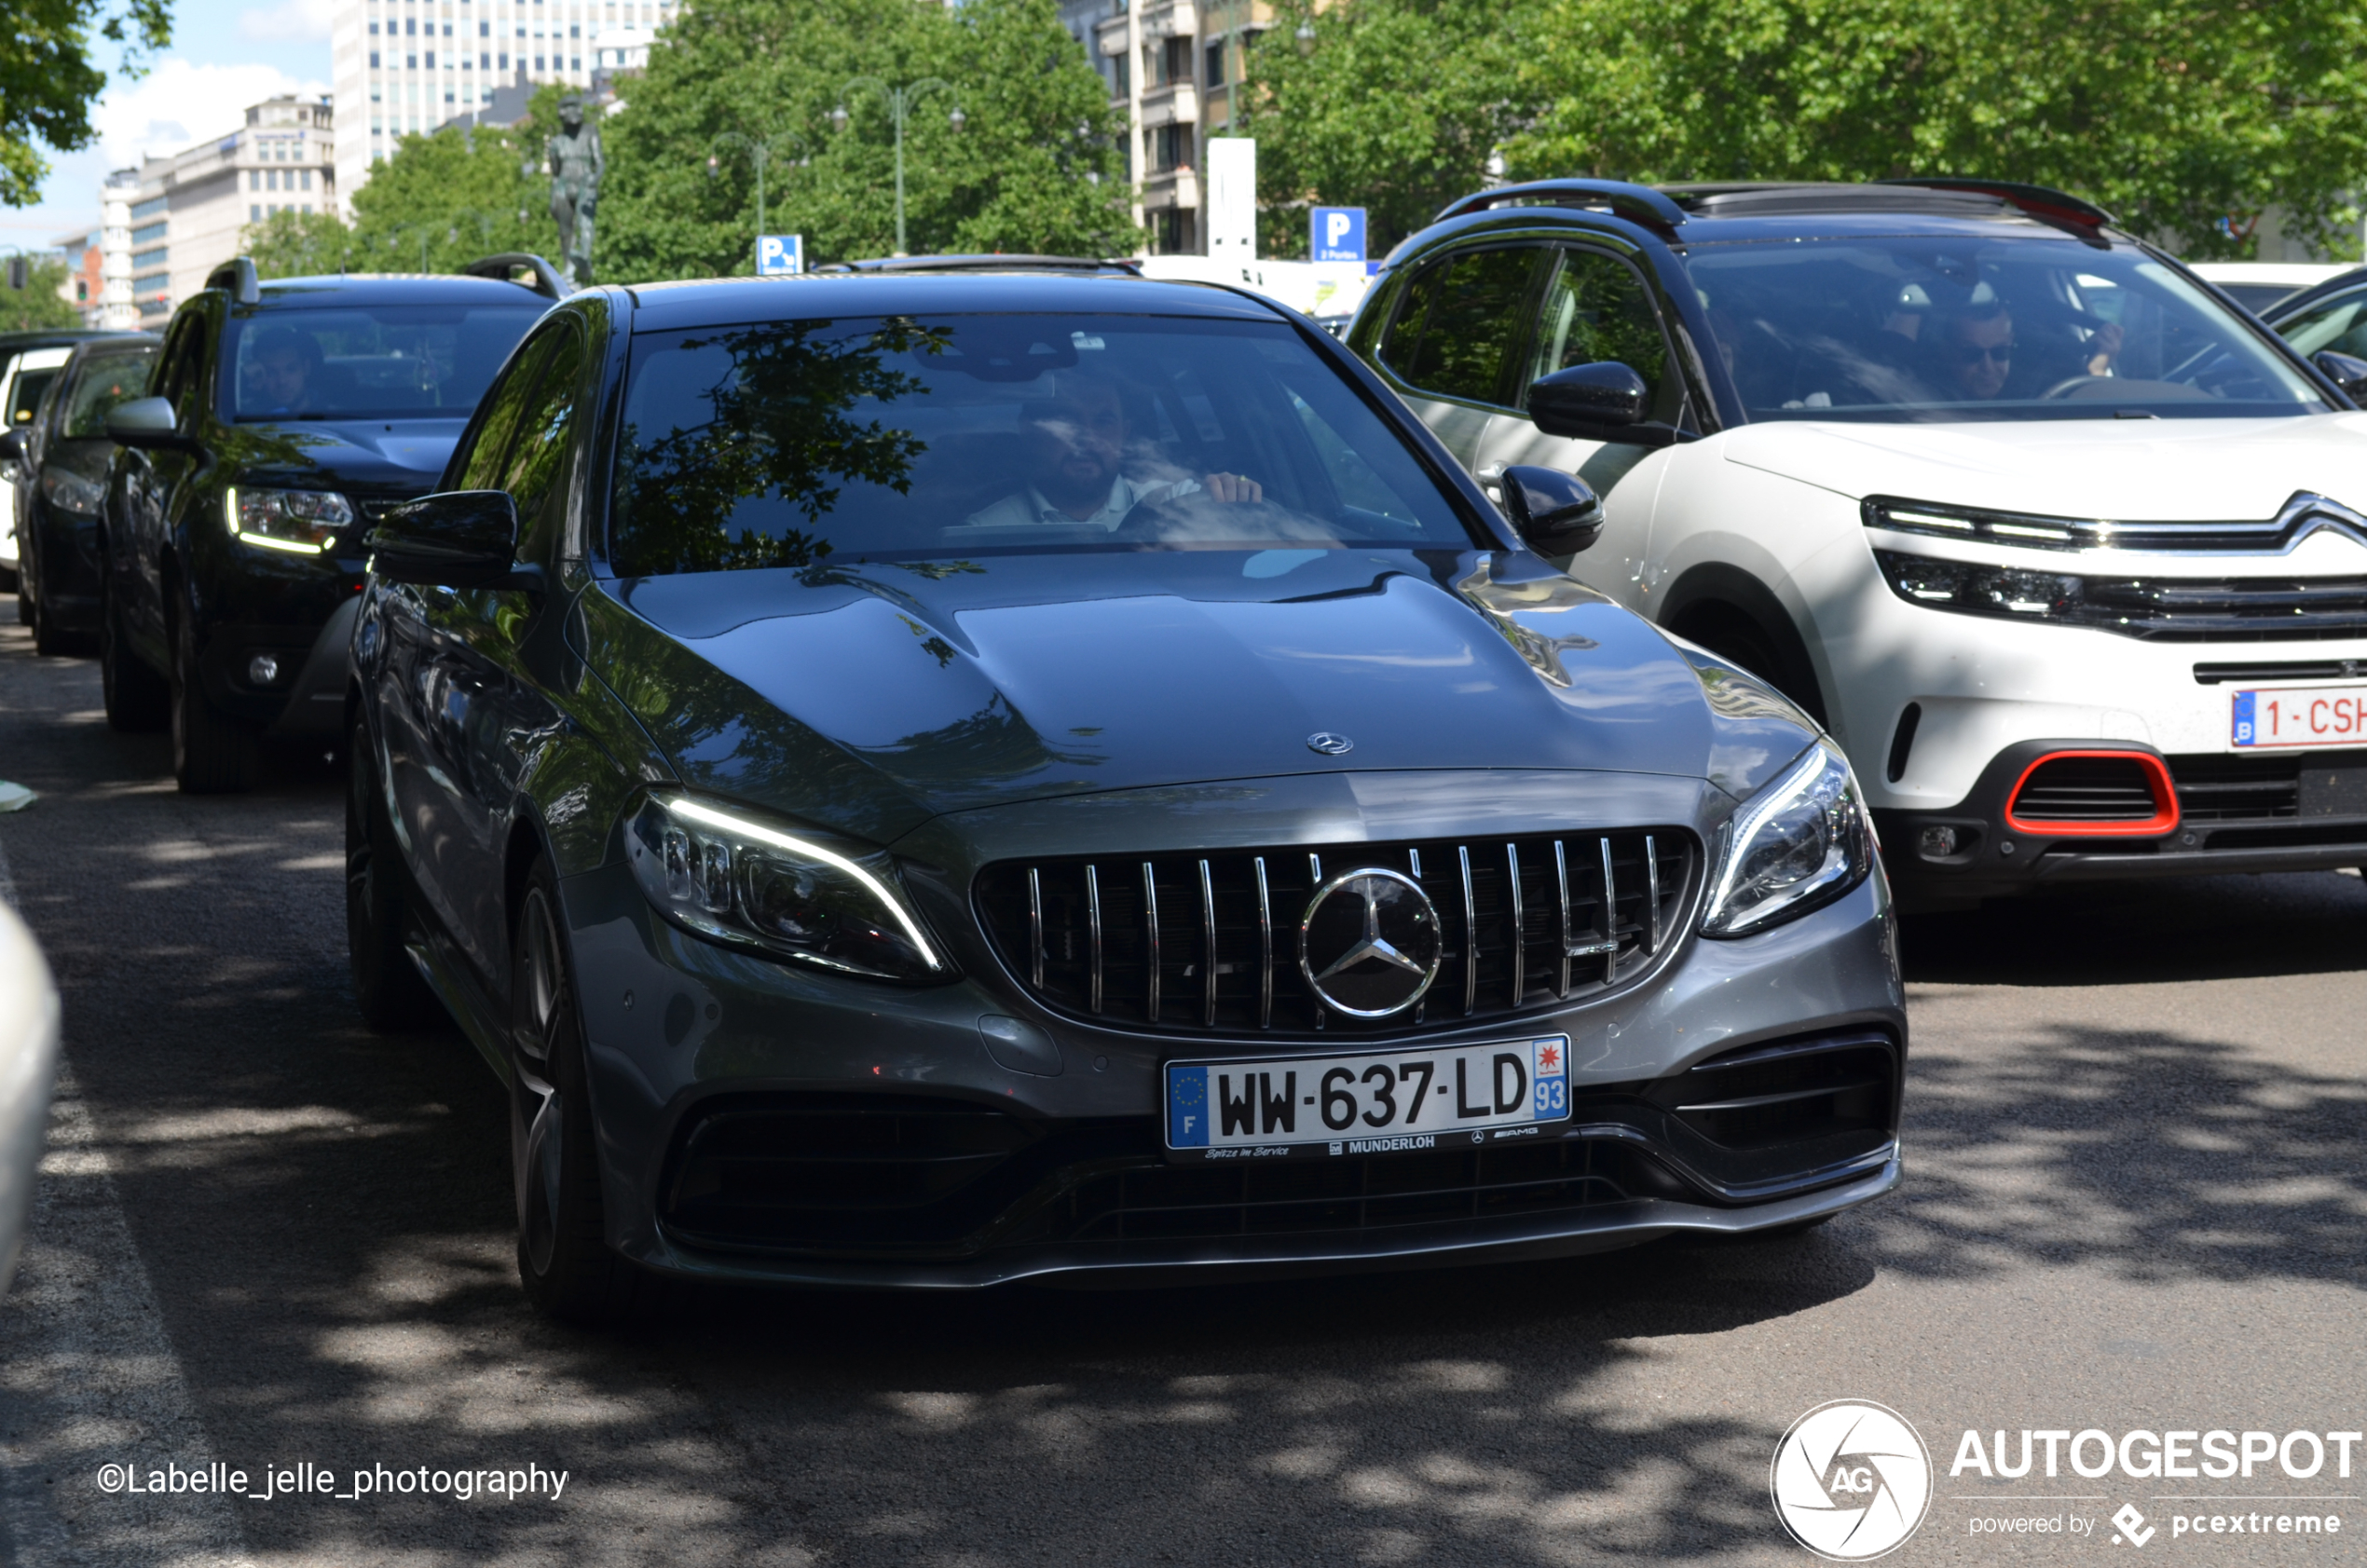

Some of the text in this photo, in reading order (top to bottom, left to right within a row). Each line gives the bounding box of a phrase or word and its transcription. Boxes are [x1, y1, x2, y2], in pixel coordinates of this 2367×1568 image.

[1328, 212, 1350, 247] P
[762, 238, 783, 266] P
[2237, 722, 2252, 740] B
[1219, 1053, 1526, 1137] WW-637-LD
[1536, 1080, 1565, 1111] 93
[1184, 1116, 1196, 1134] F
[1506, 1127, 1539, 1137] AMG
[1205, 1147, 1289, 1159] Spitze im Service
[1349, 1135, 1435, 1153] MUNDERLOH
